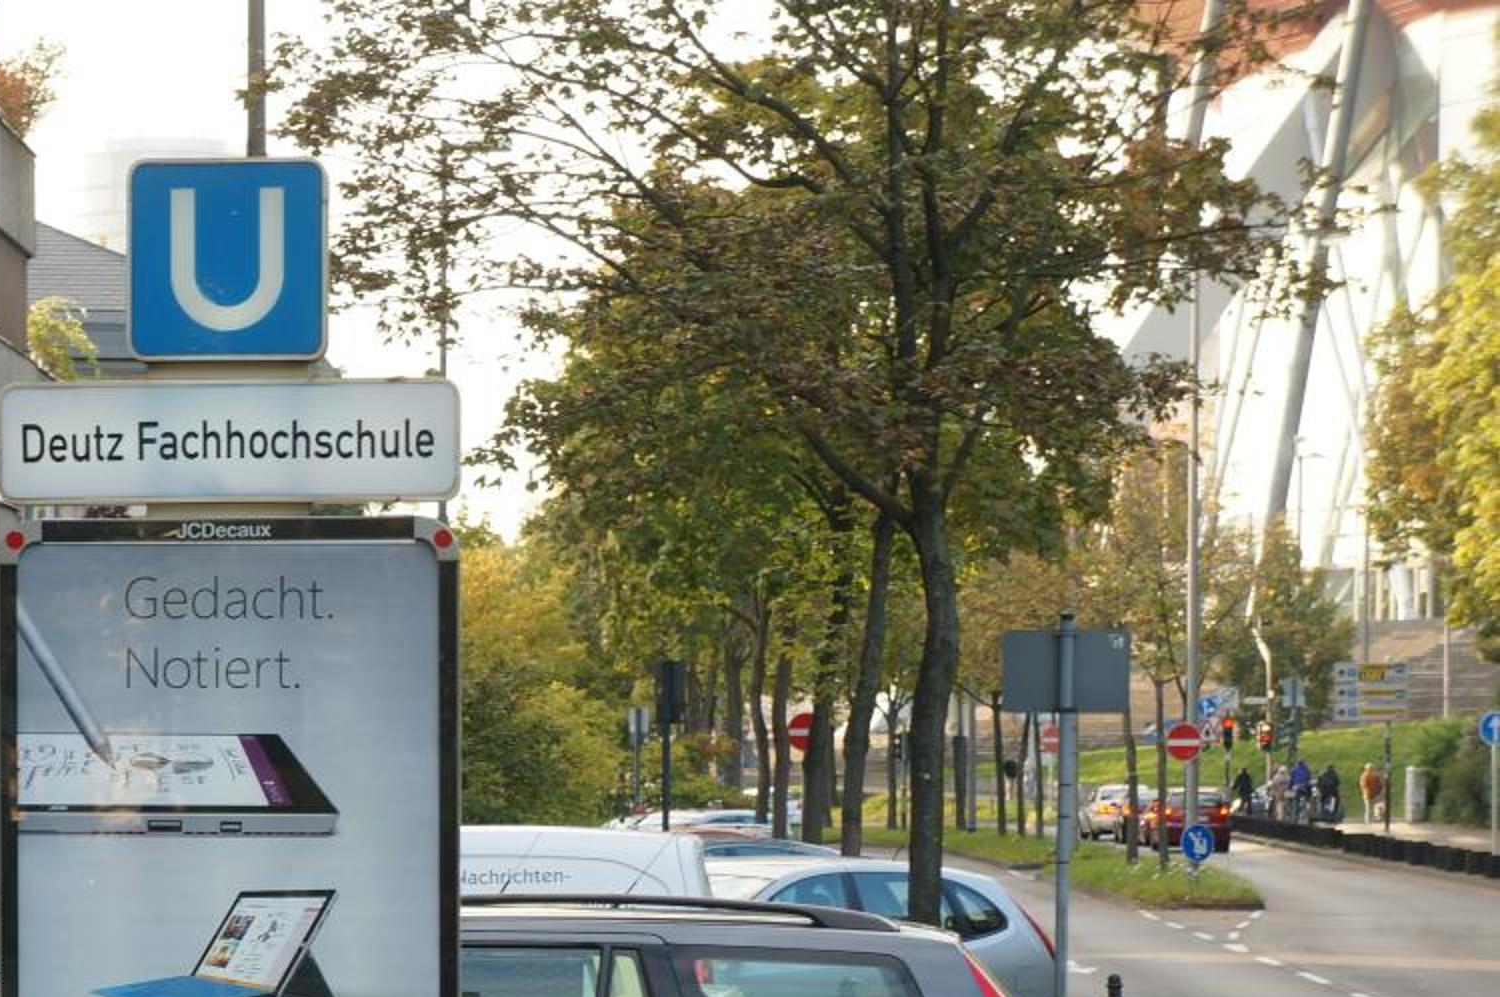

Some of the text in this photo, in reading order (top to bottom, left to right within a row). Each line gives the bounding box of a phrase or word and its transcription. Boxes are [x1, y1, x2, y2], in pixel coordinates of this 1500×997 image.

[170, 187, 285, 331] U
[21, 420, 435, 463] Deutz Fachhochschule
[178, 522, 271, 539] JCDecaux
[124, 575, 335, 620] Gedacht.
[125, 647, 301, 689] Notiert.
